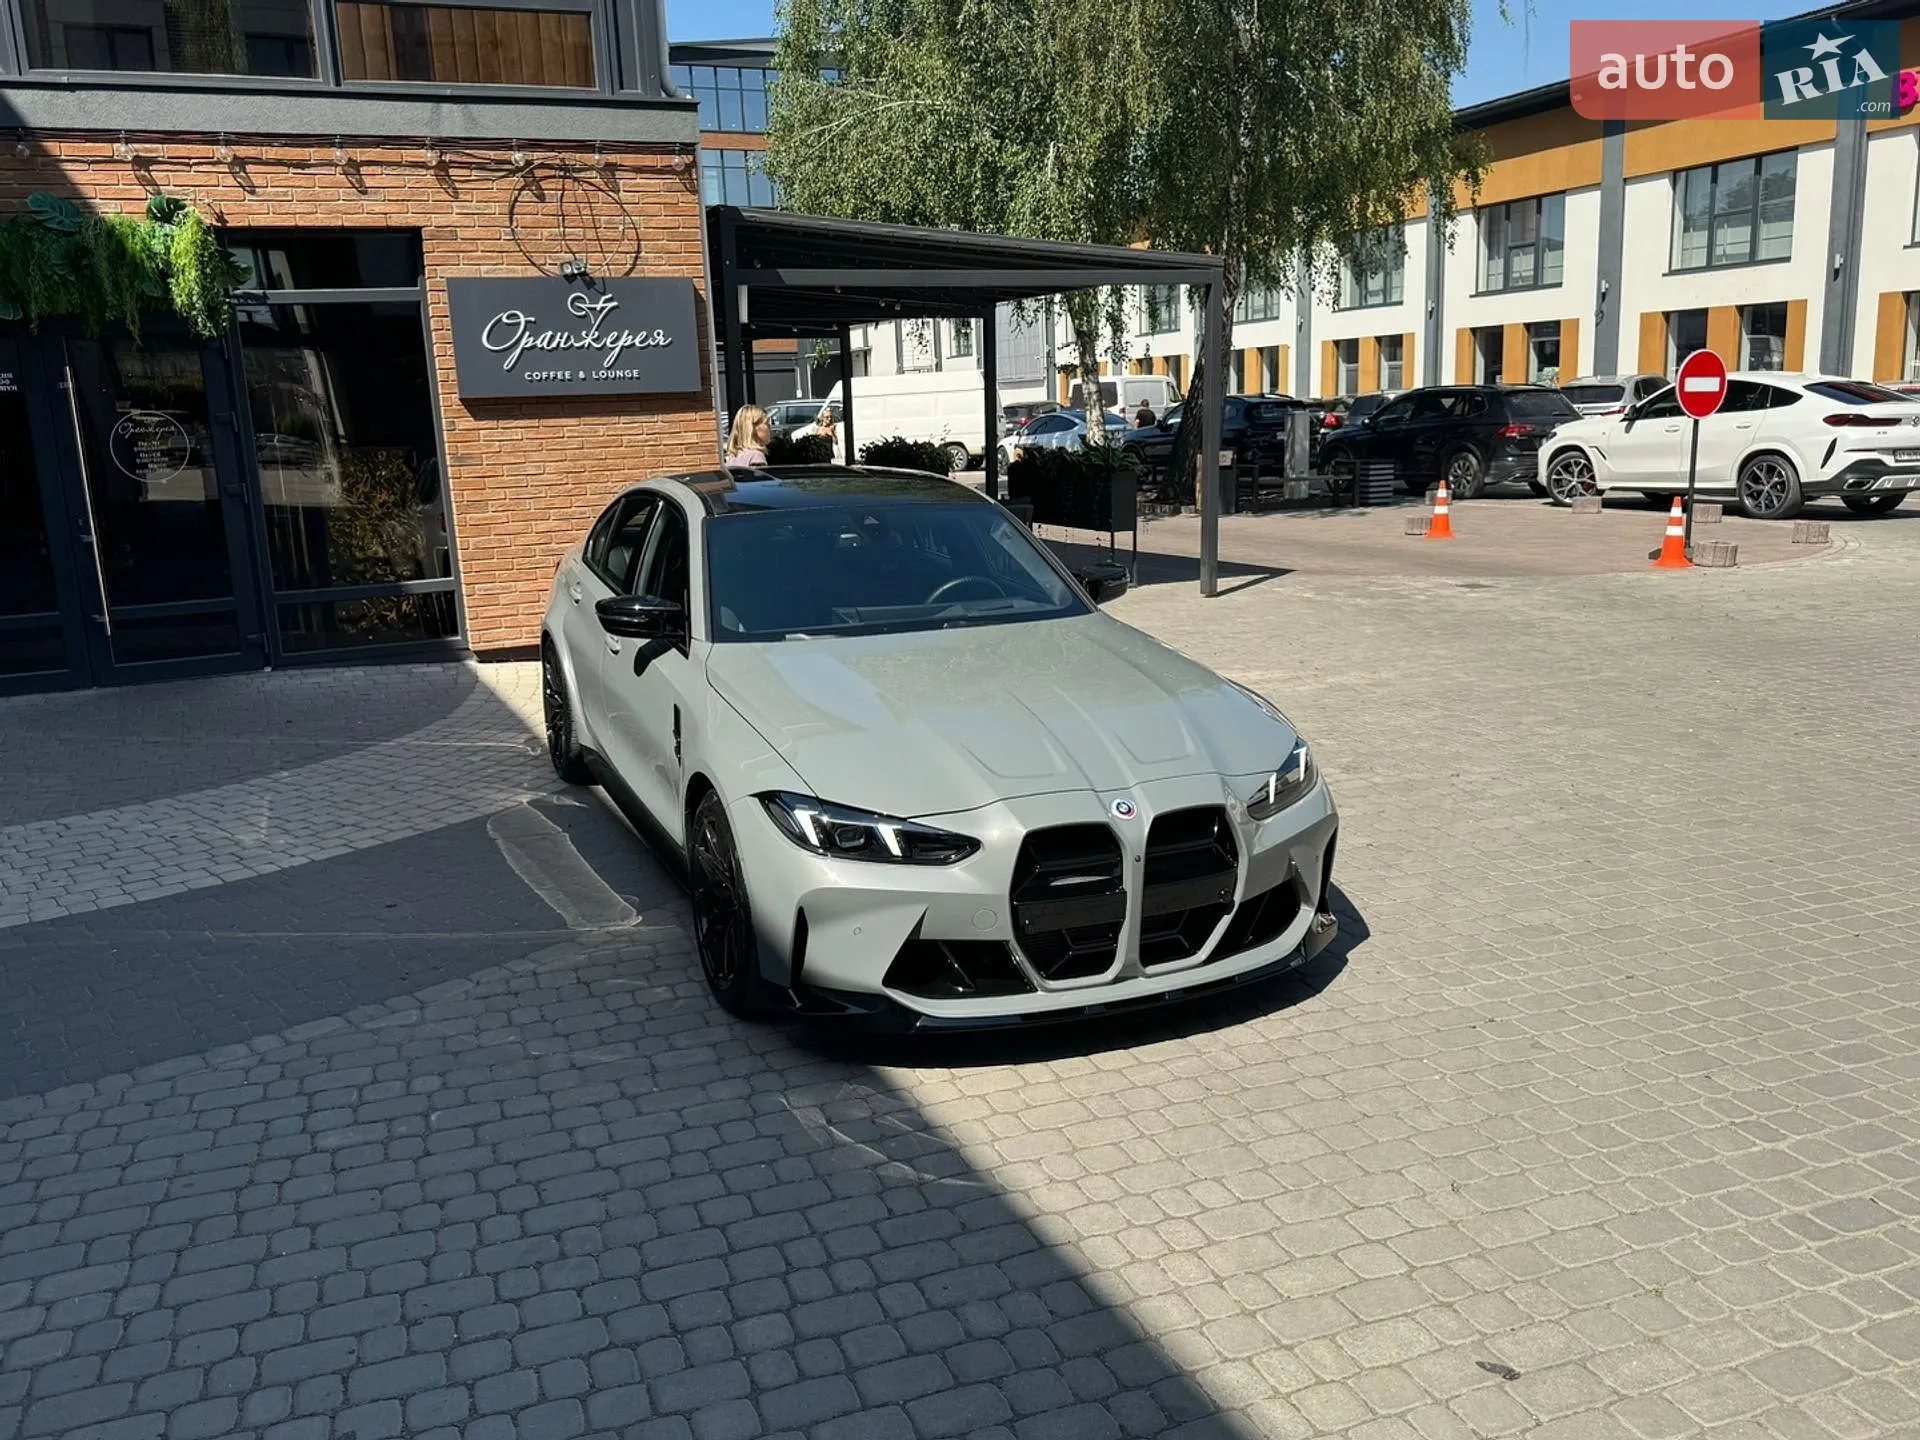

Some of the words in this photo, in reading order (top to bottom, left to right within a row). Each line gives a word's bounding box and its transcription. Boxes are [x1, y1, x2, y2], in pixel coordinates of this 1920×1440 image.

[481, 292, 673, 370] Оранжерея
[524, 370, 572, 381] COFFEE
[578, 369, 586, 380] &
[592, 369, 640, 380] LOUNGE
